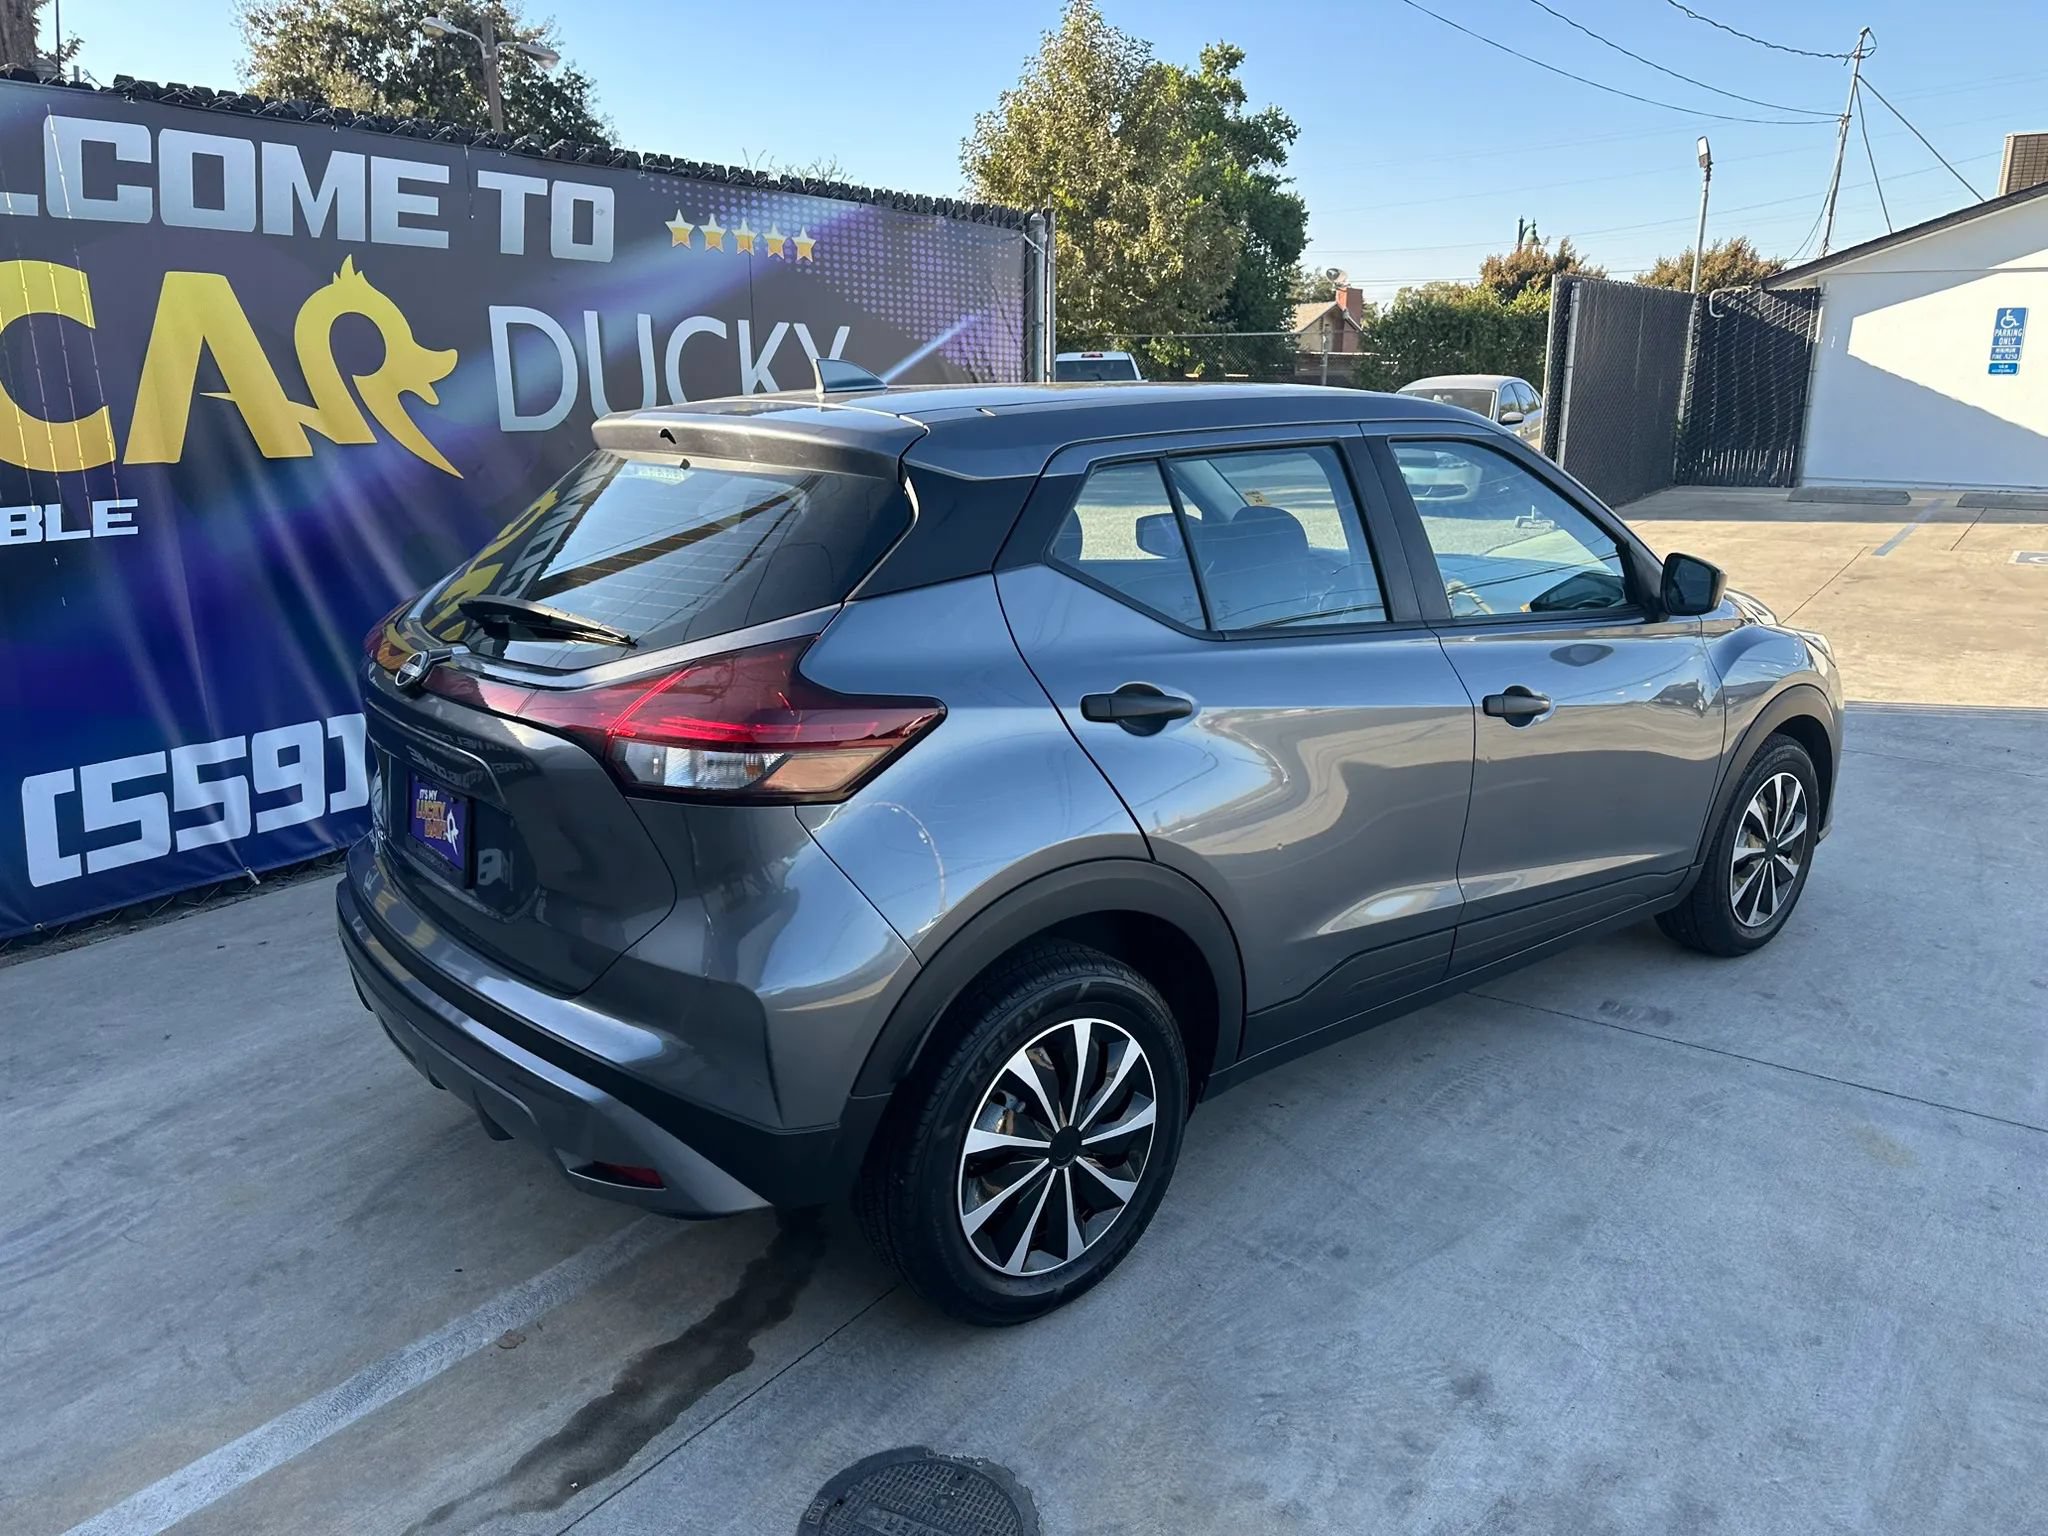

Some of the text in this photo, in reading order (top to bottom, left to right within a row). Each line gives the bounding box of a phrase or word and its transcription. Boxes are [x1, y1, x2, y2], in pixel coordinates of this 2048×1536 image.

[0, 114, 615, 263] COME TO
[1994, 328, 2023, 337] PARKING
[1998, 337, 2016, 345] ONLY
[488, 304, 850, 432] DUCKY
[21, 712, 370, 888] (559)
[429, 790, 438, 800] MY
[415, 799, 446, 821] LUCKY
